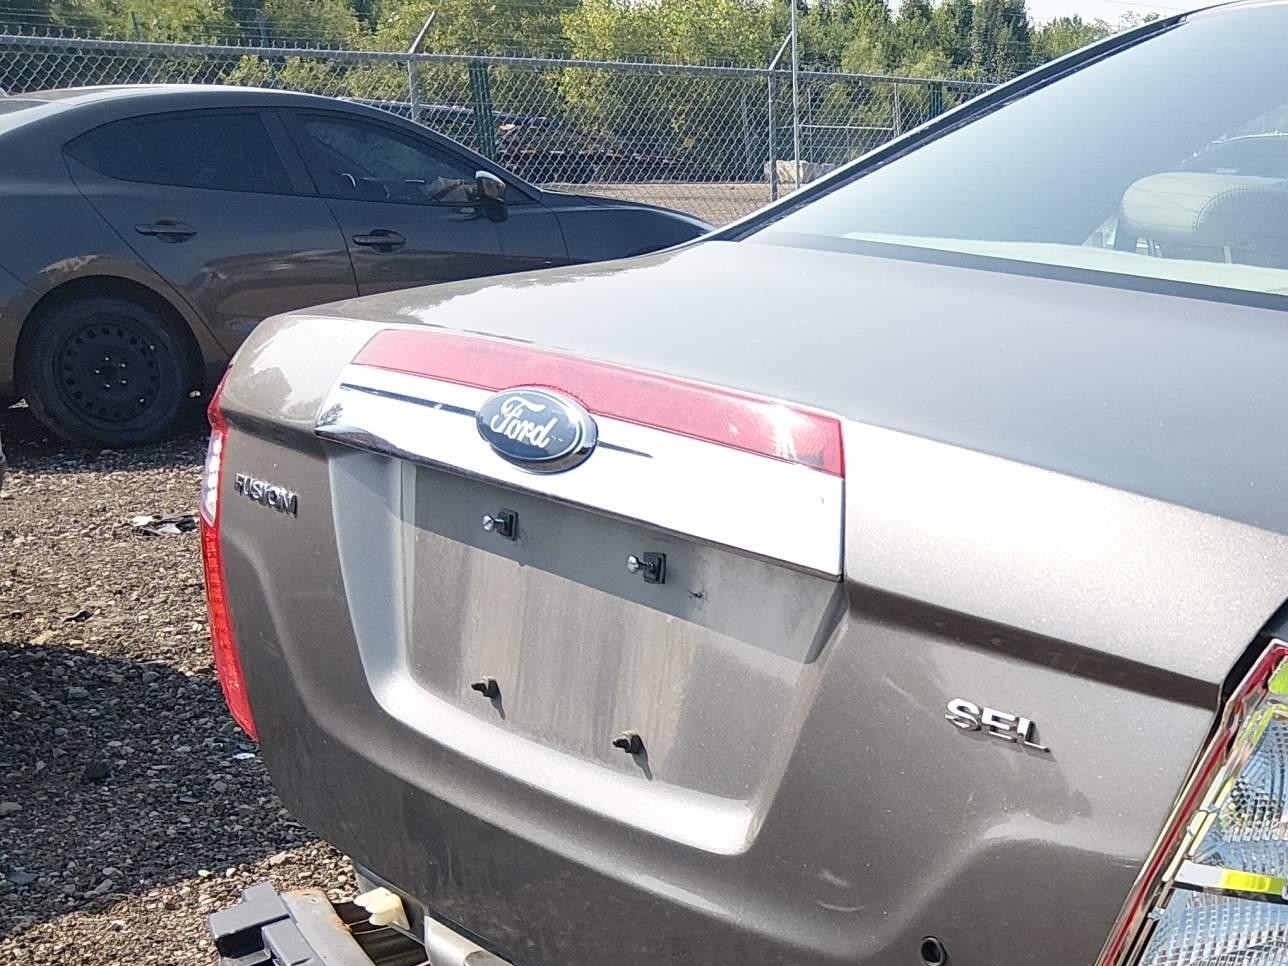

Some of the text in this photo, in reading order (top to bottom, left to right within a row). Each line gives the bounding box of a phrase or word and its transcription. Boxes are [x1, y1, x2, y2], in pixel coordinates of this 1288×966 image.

[490, 396, 559, 449] Ford
[234, 472, 298, 518] FUSION
[944, 698, 1050, 753] SEL
